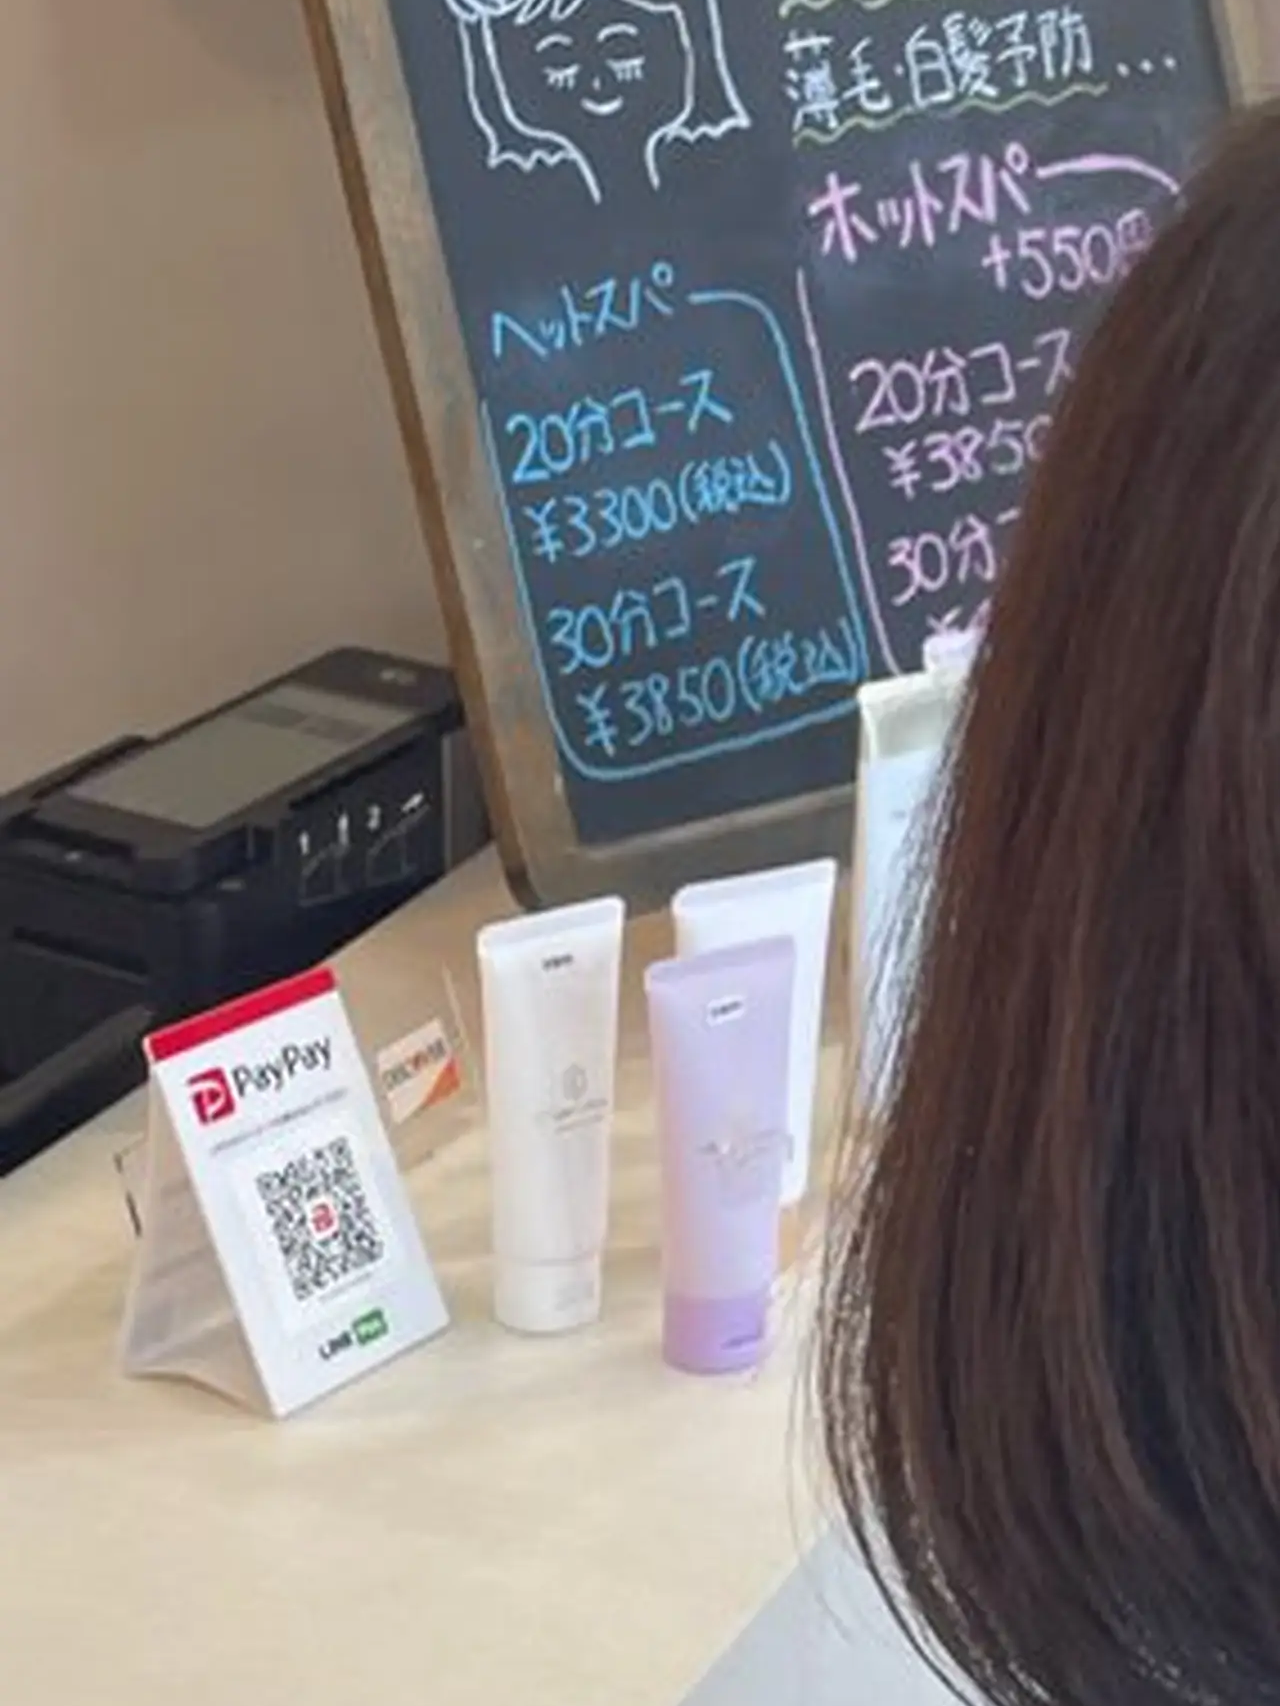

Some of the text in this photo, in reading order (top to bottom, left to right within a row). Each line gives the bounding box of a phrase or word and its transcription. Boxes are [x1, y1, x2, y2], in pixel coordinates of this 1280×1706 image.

[808, 141, 1032, 263] ホットスパ
[505, 369, 734, 484] 20分コース
[546, 554, 767, 676] 30分コース
[230, 1037, 332, 1098] PayPay
